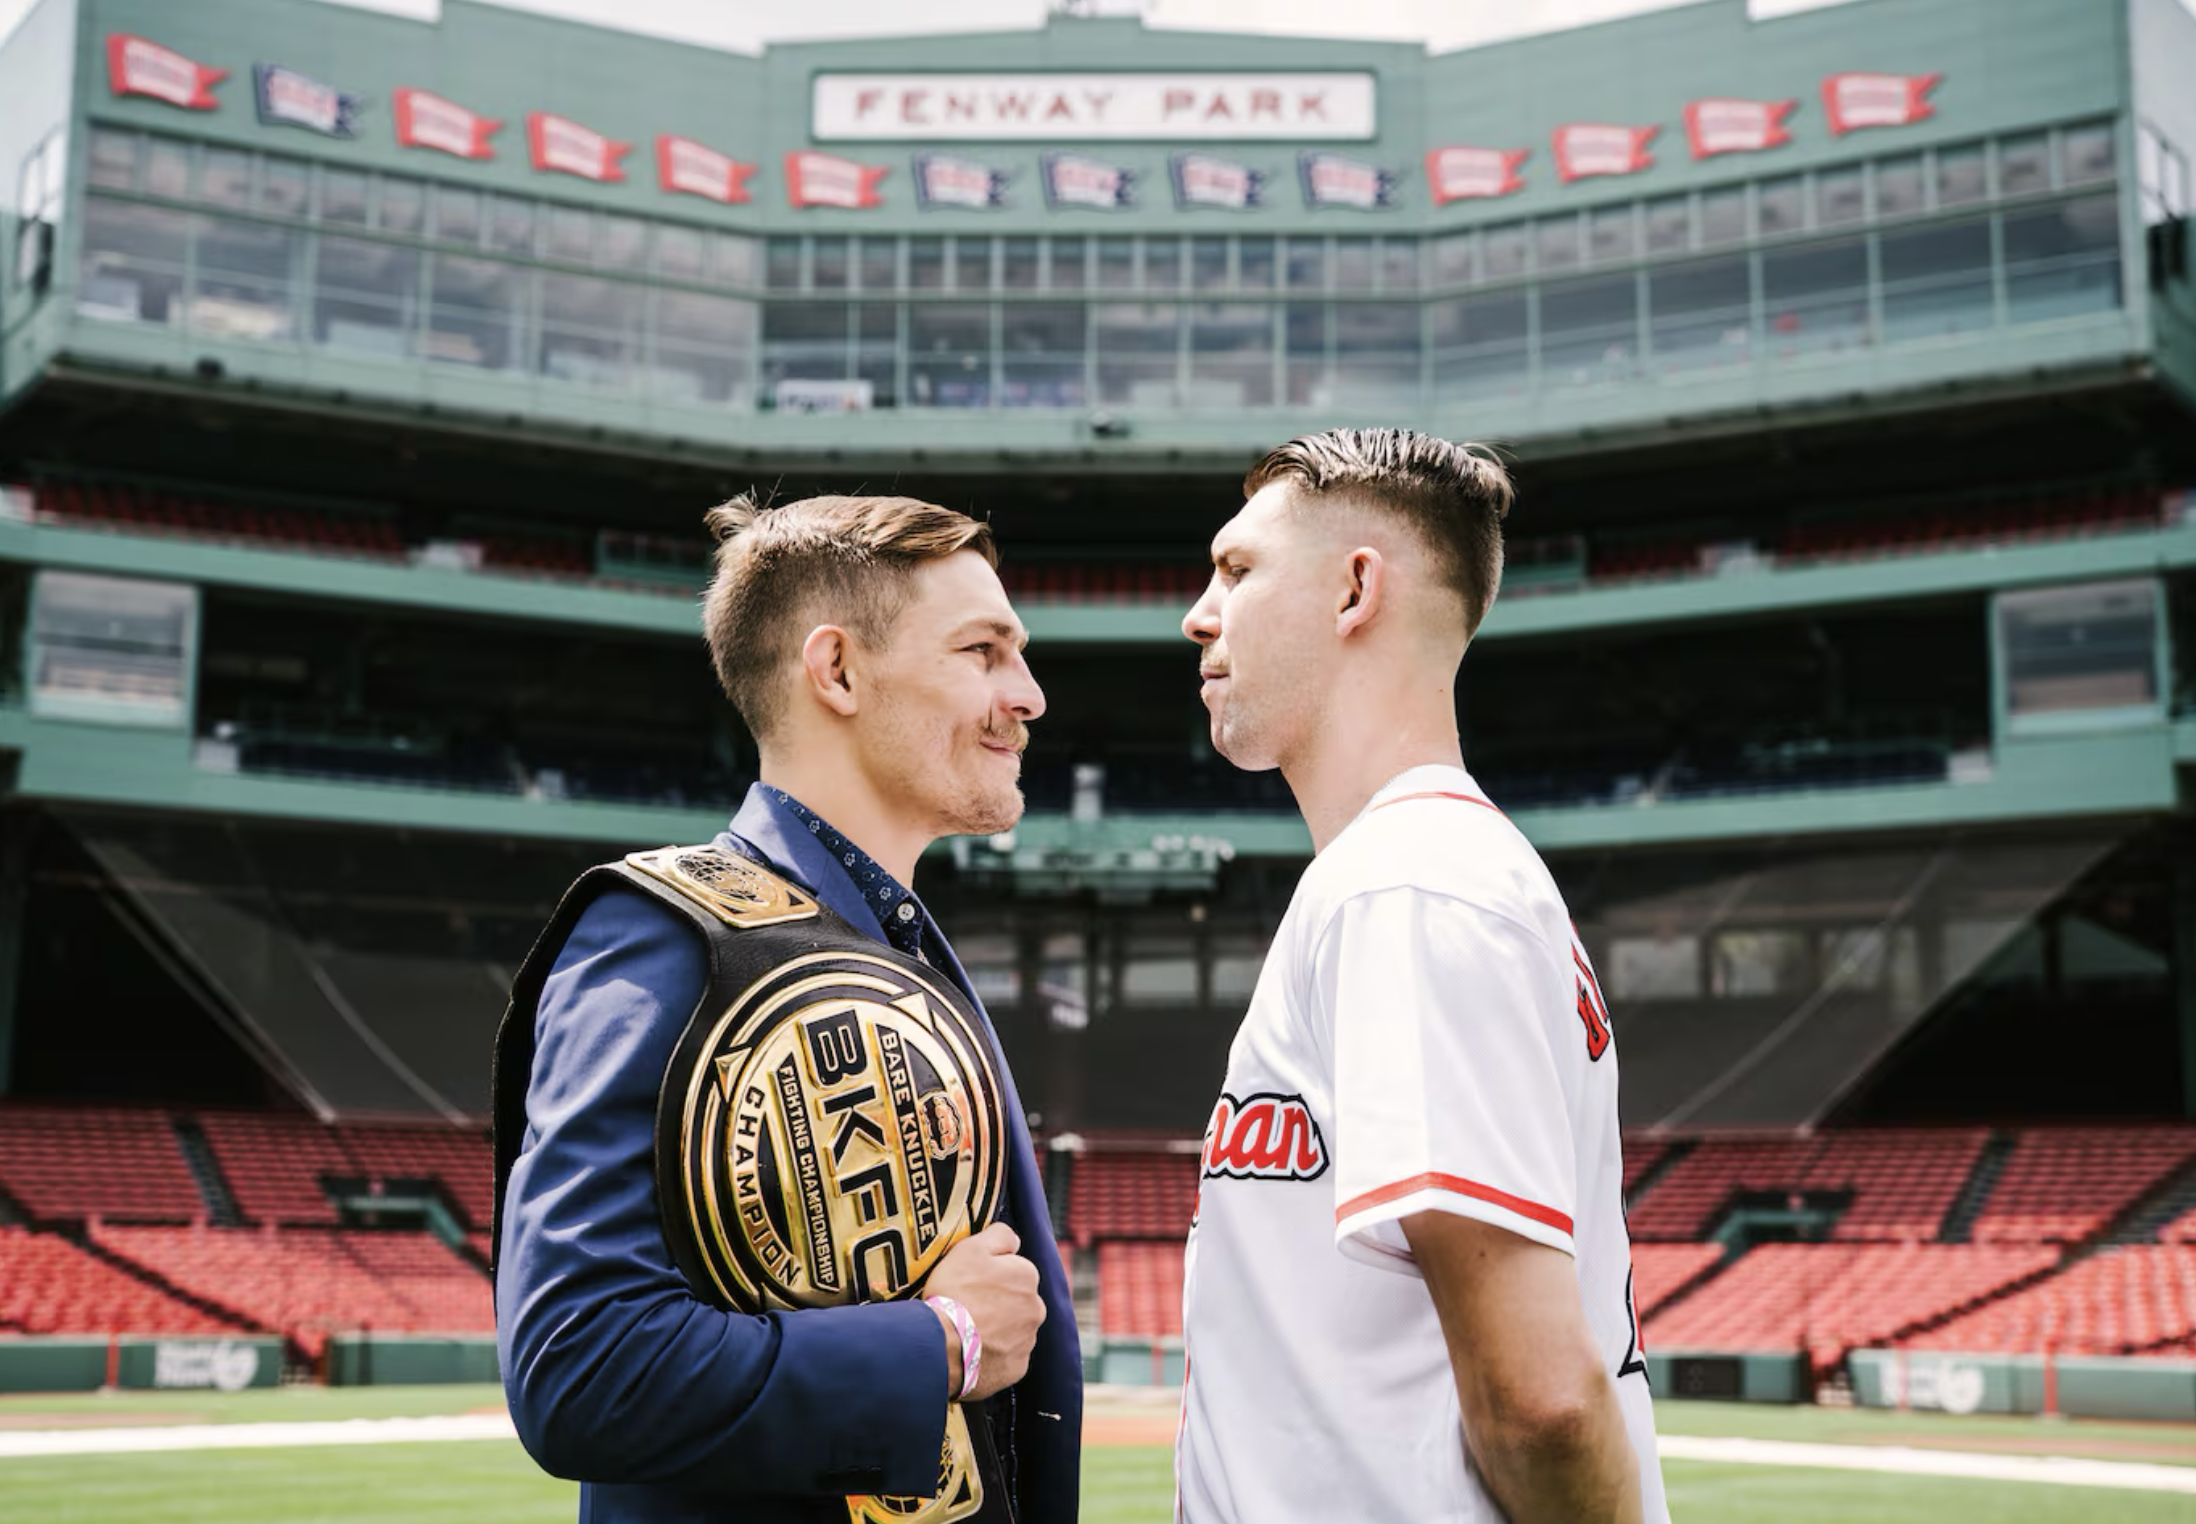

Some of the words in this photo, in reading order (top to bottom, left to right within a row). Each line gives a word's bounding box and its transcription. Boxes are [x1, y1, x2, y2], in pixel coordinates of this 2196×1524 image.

[855, 88, 1114, 124] FENWAY
[1163, 88, 1330, 124] PARK
[735, 1085, 801, 1286] CHAMPION
[780, 1065, 810, 1150] FIGHTING
[800, 1153, 834, 1283] CHAMPIONSHIP
[805, 1009, 910, 1302] BKFC
[881, 1032, 911, 1105] BARE
[900, 1112, 937, 1241] KNUCKLE
